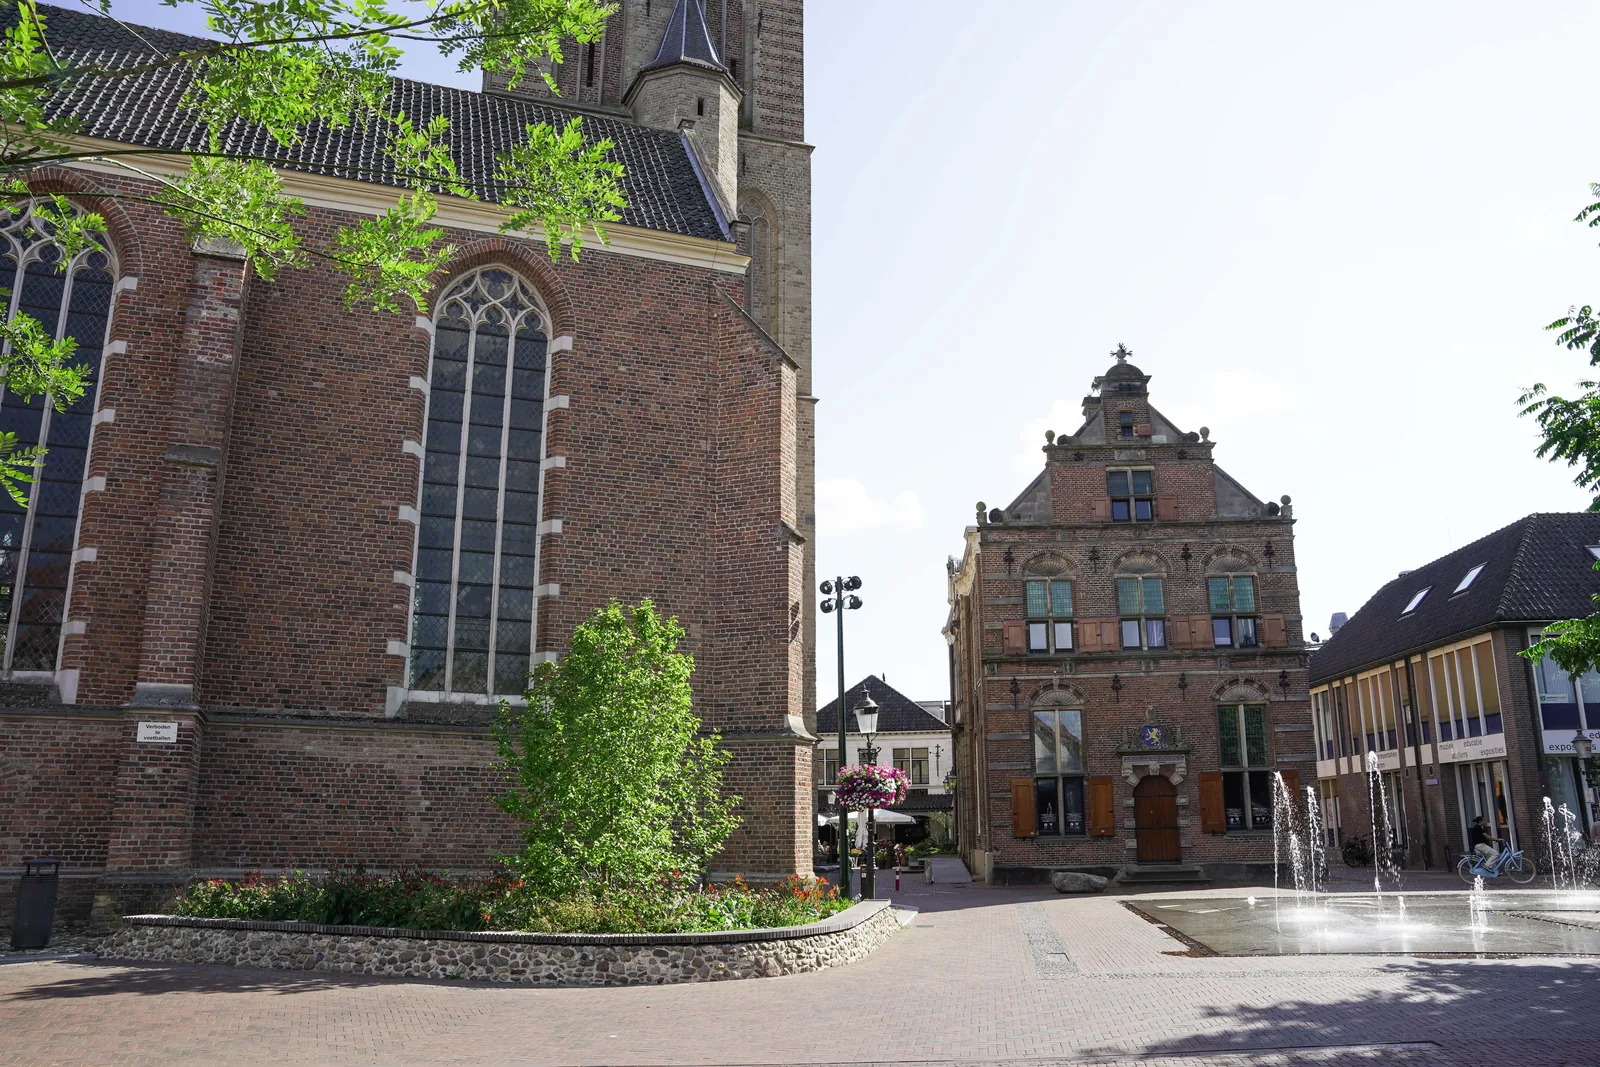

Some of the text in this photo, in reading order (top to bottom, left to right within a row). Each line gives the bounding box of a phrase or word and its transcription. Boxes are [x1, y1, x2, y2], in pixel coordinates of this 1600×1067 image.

[1463, 739, 1483, 748] educatie
[1548, 744, 1597, 752] exposs
[1480, 747, 1504, 756] exposities
